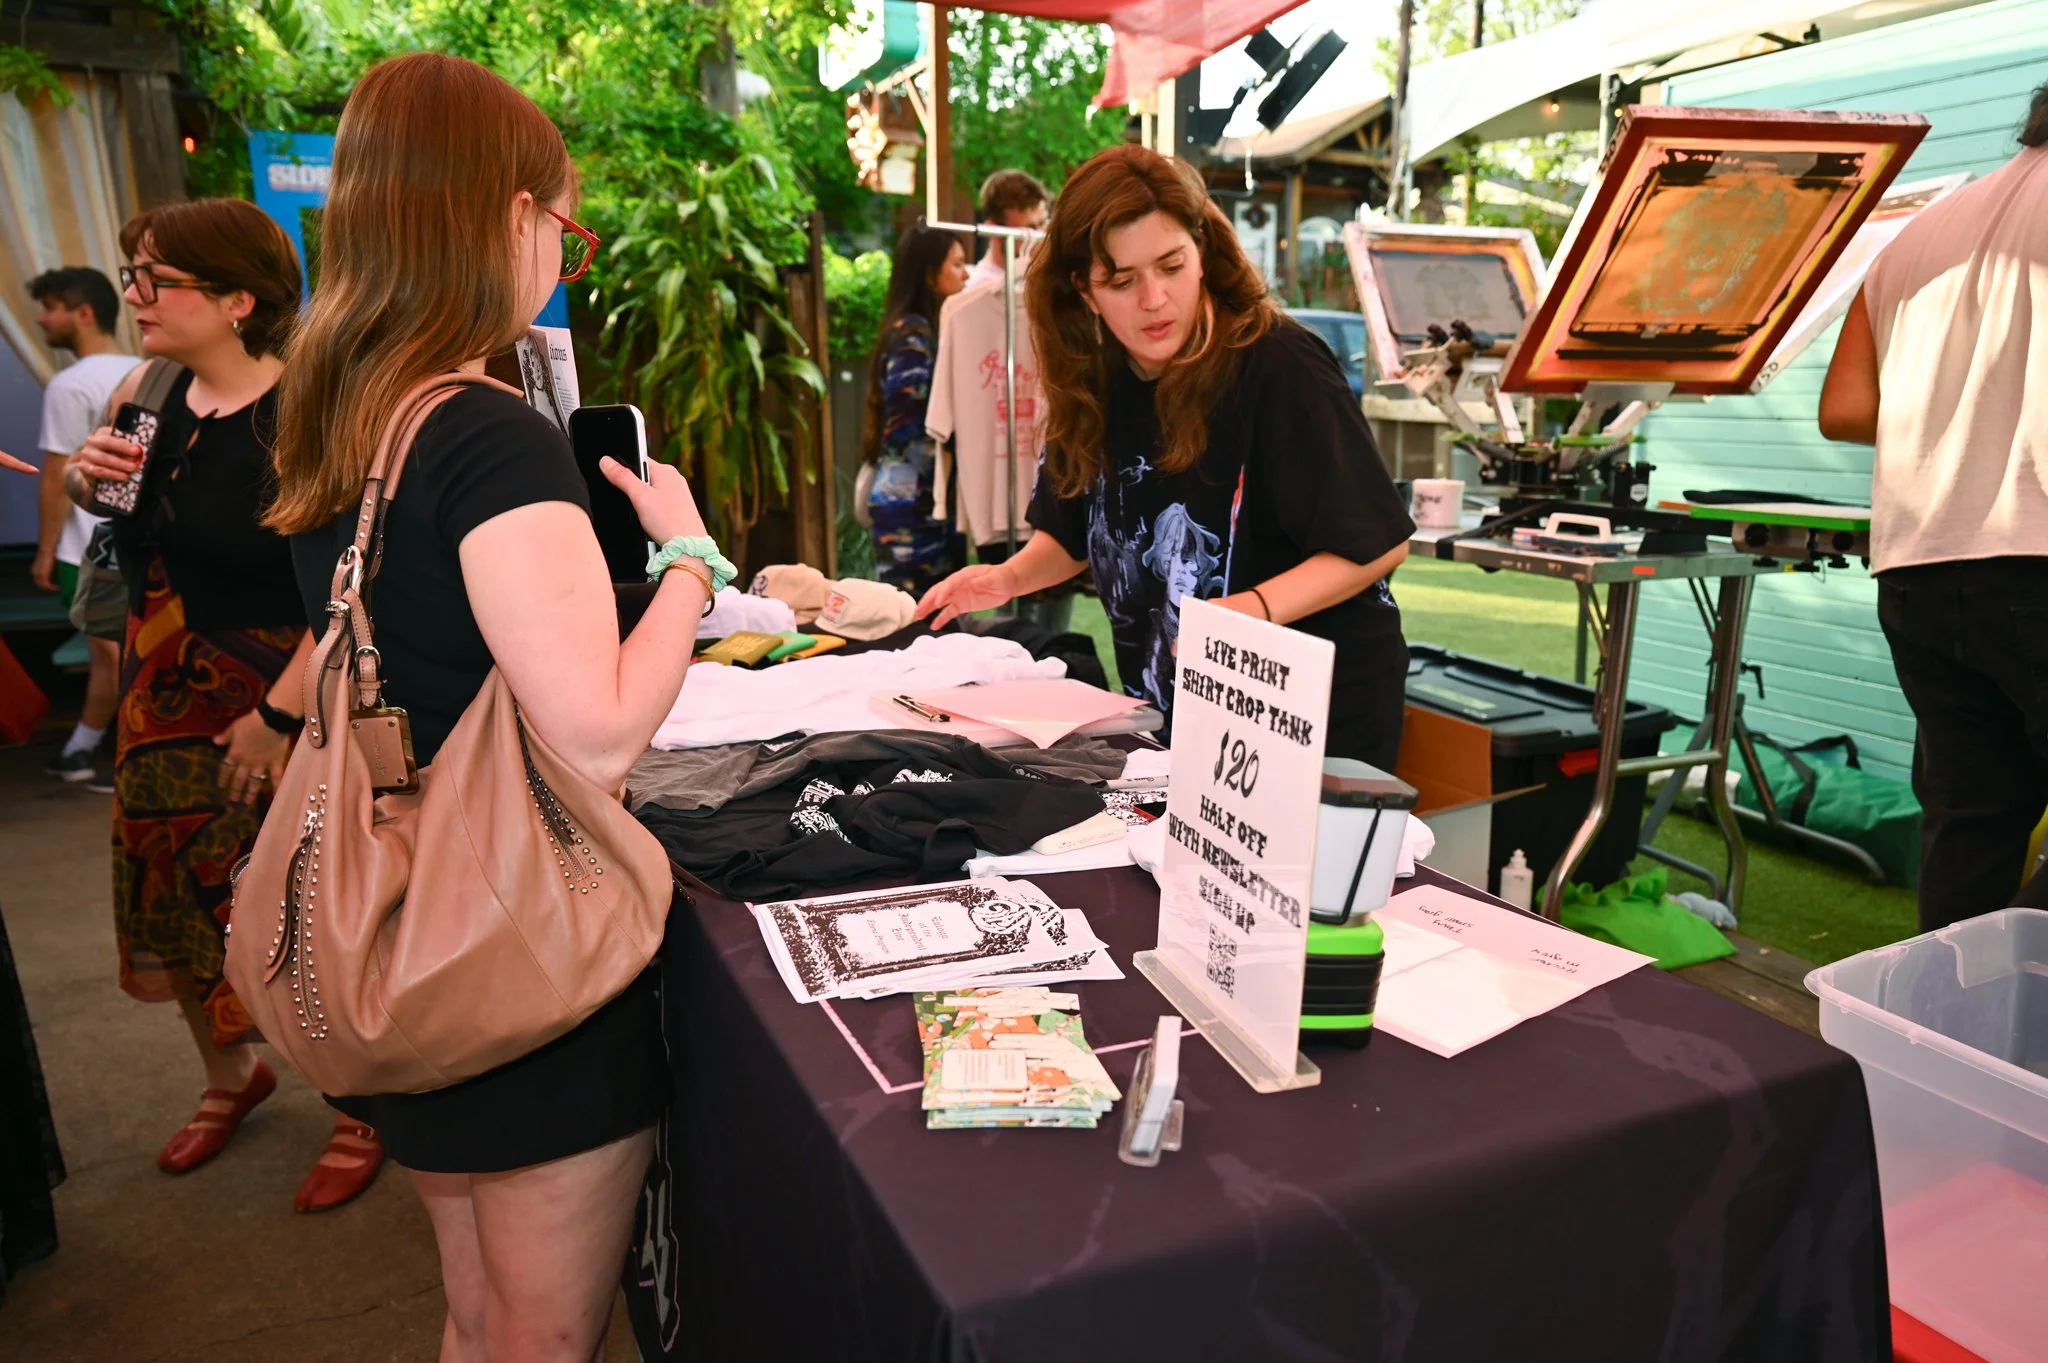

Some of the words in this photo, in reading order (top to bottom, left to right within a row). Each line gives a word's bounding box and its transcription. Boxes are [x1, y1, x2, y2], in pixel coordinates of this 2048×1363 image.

[1205, 636, 1236, 670] LIVE
[1240, 650, 1290, 691] PRINT
[1182, 667, 1224, 706] SHIRT
[1226, 686, 1265, 725] CROP
[1268, 704, 1313, 746] TANK
[1213, 728, 1260, 798] $20
[1200, 795, 1236, 837] HALF
[1237, 821, 1267, 858] OFF
[1169, 812, 1200, 855] WITH
[1202, 837, 1302, 928] NEWSLETTER
